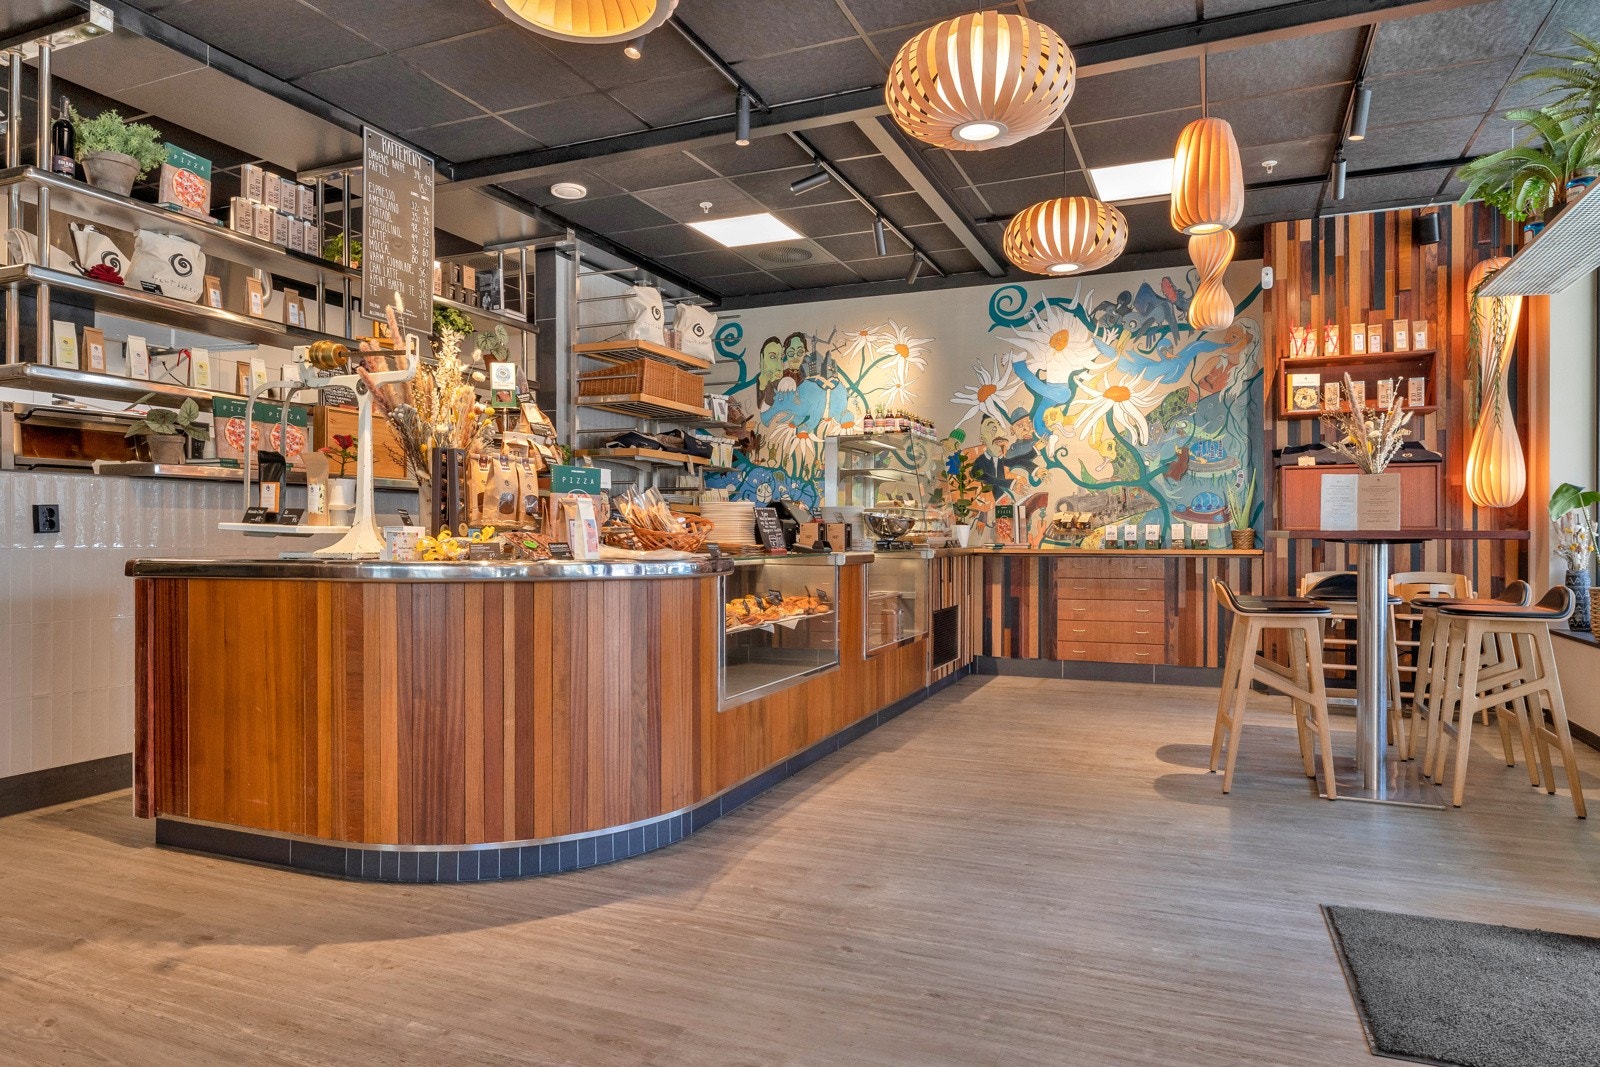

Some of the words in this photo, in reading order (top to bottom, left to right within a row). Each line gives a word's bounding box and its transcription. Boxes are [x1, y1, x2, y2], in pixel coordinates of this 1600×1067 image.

[368, 147, 390, 166] DAGENS
[391, 159, 406, 174] KAFFE
[382, 137, 422, 170] KAFFEMENY
[173, 154, 205, 172] PIZZA
[368, 159, 390, 178] PÅFYLL
[368, 181, 396, 202] ESPRESSO
[368, 193, 400, 215] AMERICANO
[370, 250, 385, 265] VARM
[370, 261, 382, 275] CHAI
[369, 284, 378, 297] TE
[370, 272, 386, 287] ÅPENT
[409, 284, 416, 297] TE
[223, 404, 257, 414] PIZA
[268, 411, 301, 420] PIZA
[562, 476, 595, 485] PIZZA
